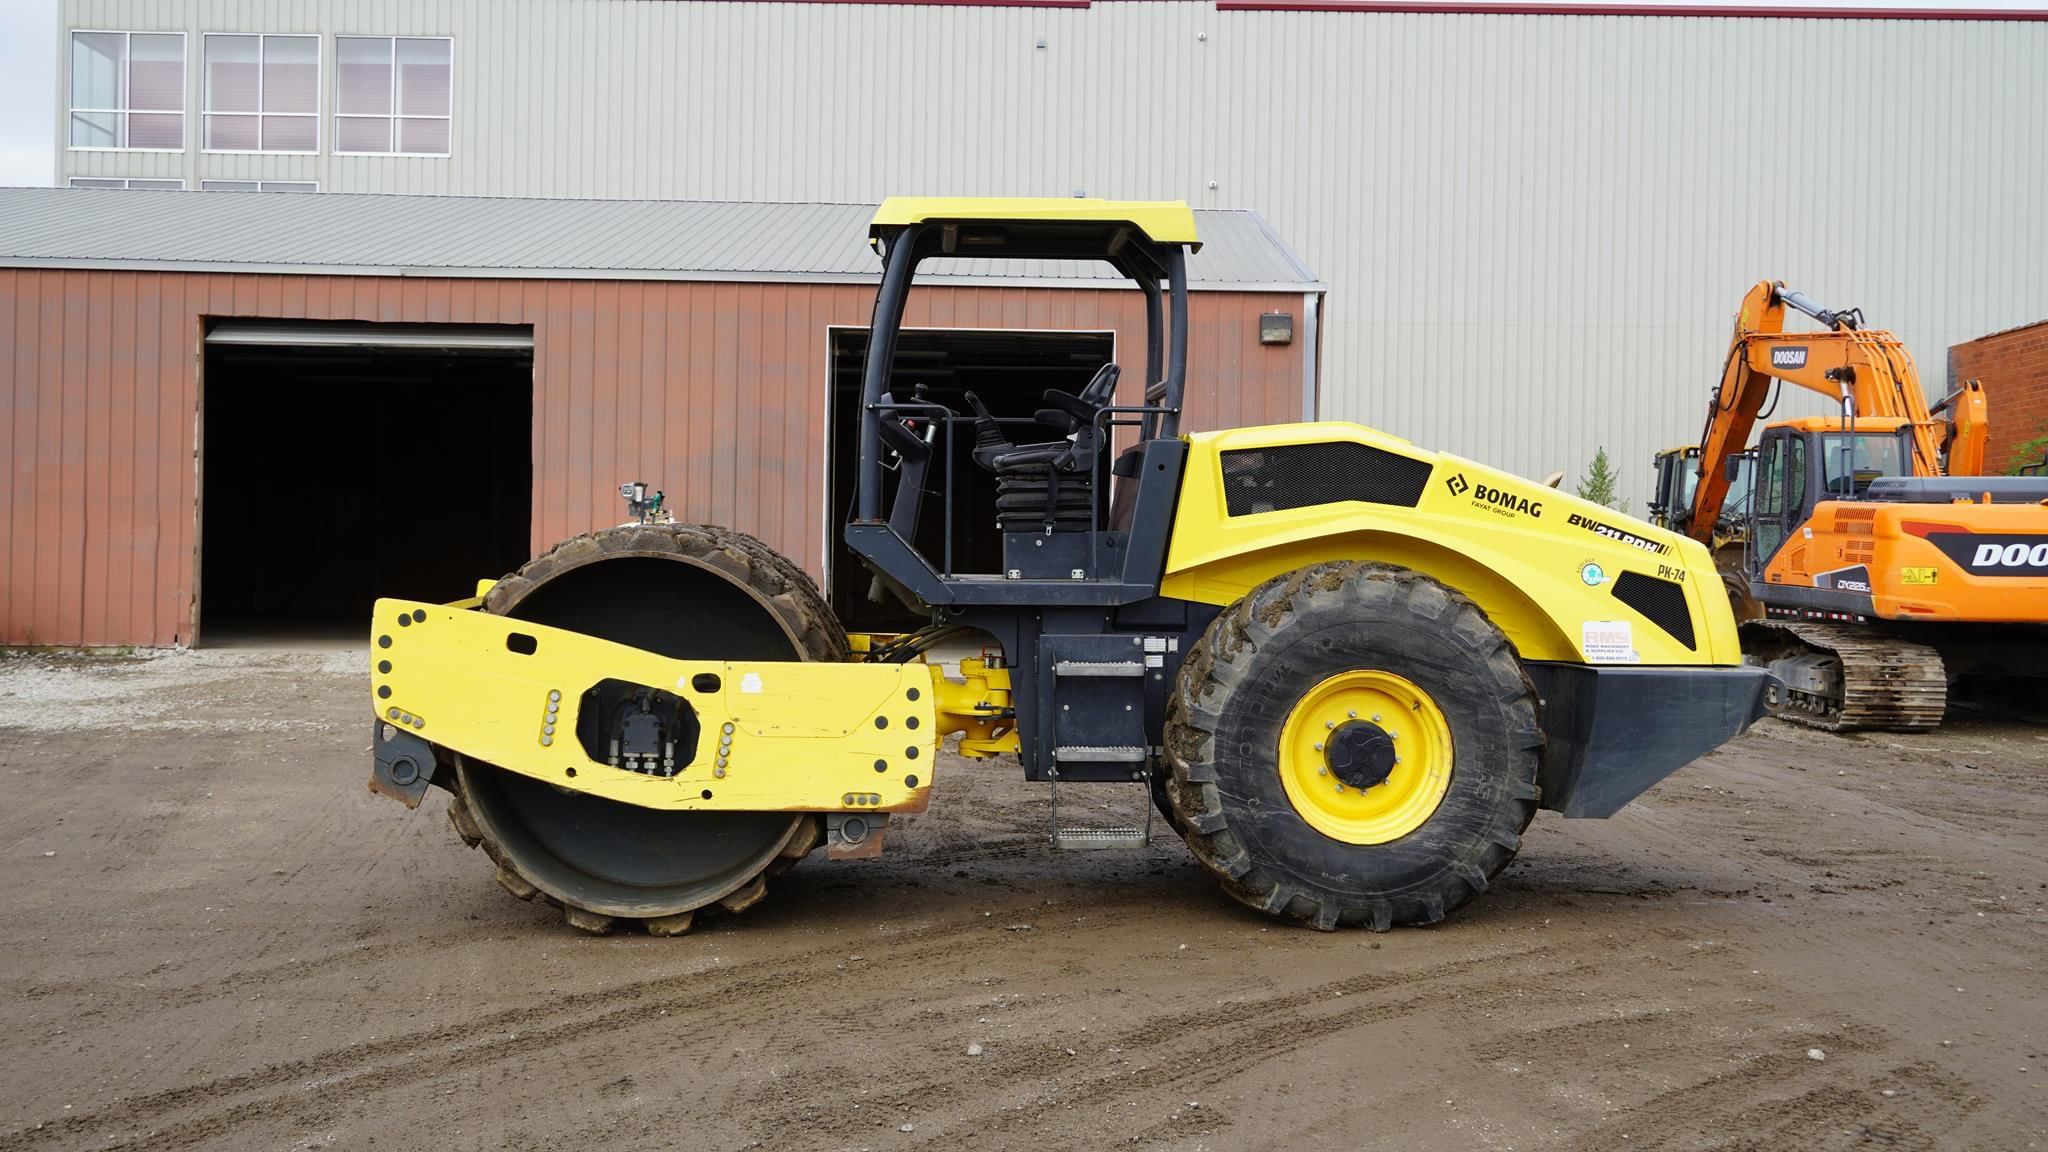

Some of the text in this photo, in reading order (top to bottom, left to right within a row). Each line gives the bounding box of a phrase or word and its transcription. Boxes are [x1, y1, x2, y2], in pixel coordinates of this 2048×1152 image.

[1773, 350, 1806, 365] DOOSAN
[1471, 501, 1516, 518] FAYAT GROUP
[1473, 484, 1543, 519] BOMAG
[1657, 564, 1686, 583] PK-74
[1584, 631, 1630, 644] RMS
